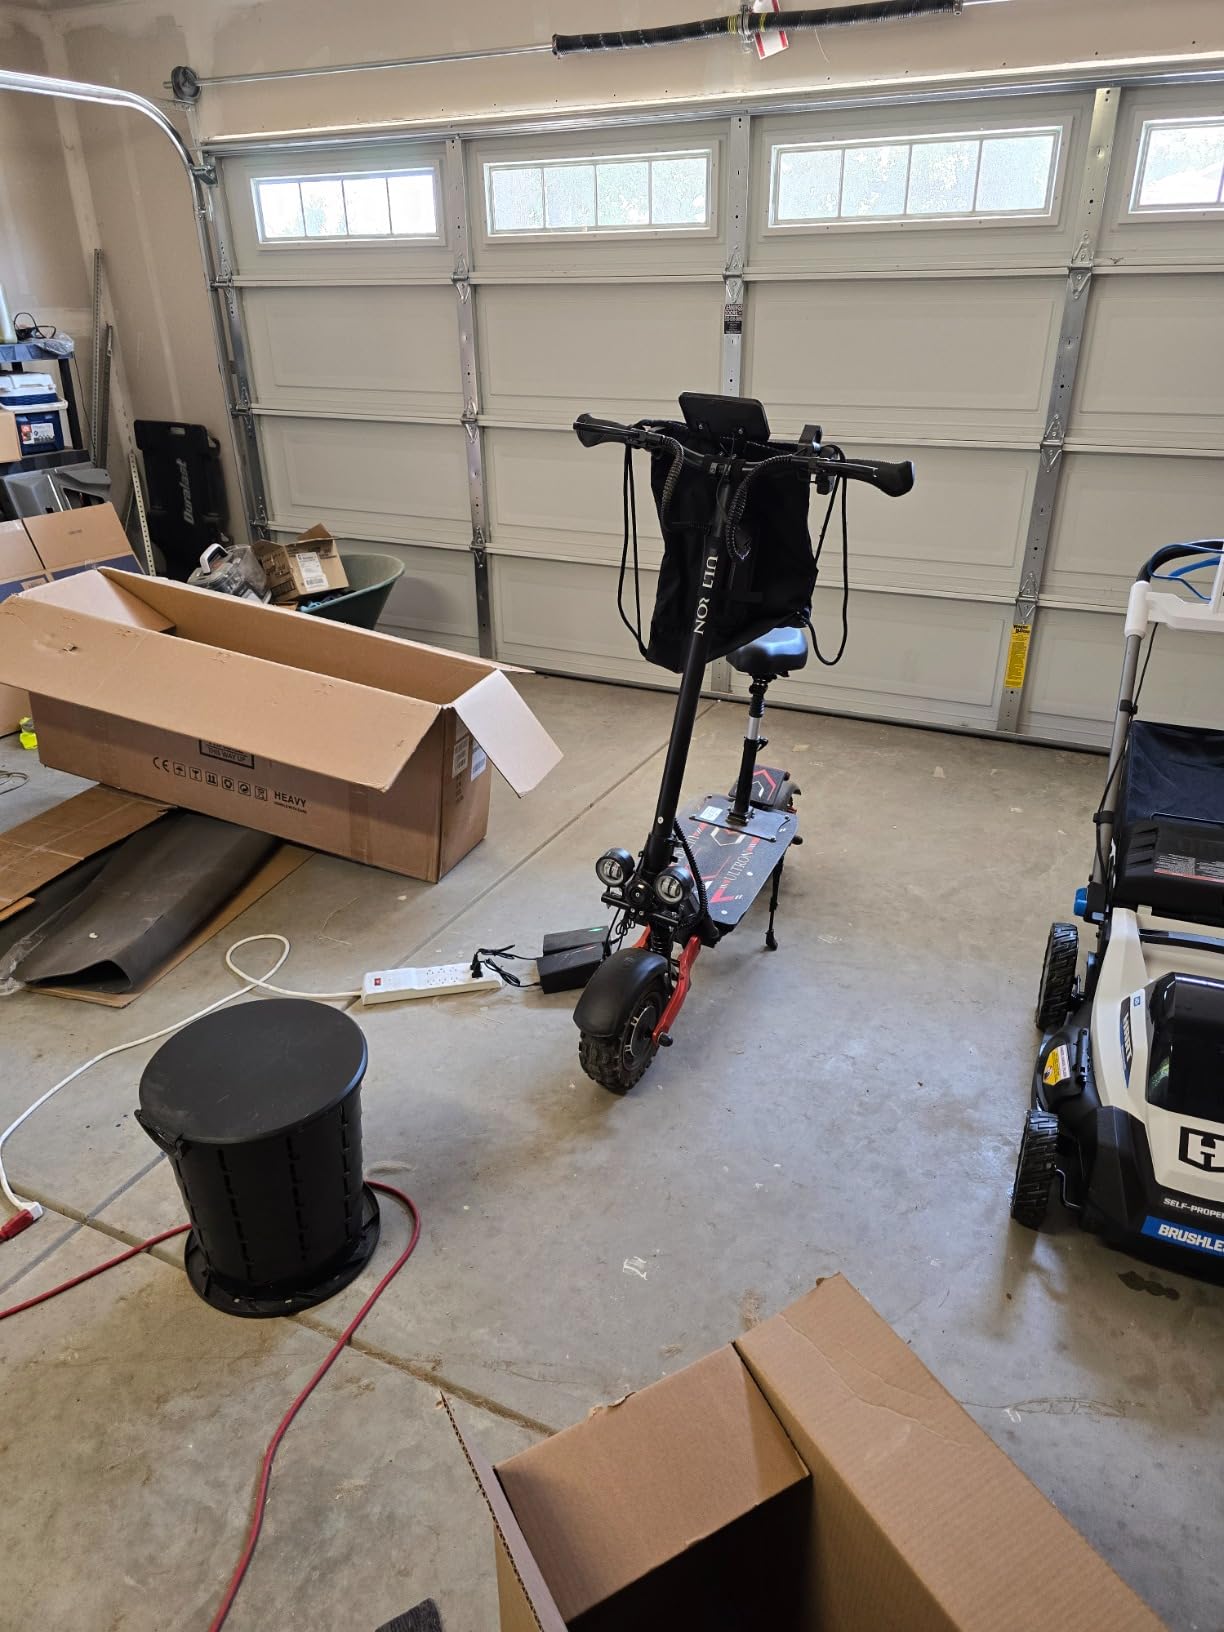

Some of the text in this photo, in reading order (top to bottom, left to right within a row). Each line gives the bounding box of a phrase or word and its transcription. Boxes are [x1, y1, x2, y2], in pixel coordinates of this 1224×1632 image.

[175, 457, 194, 525] Duralast
[274, 791, 307, 808] HEAVY
[727, 850, 754, 881] ULTRON
[1158, 1223, 1224, 1254] BRUSHLE
